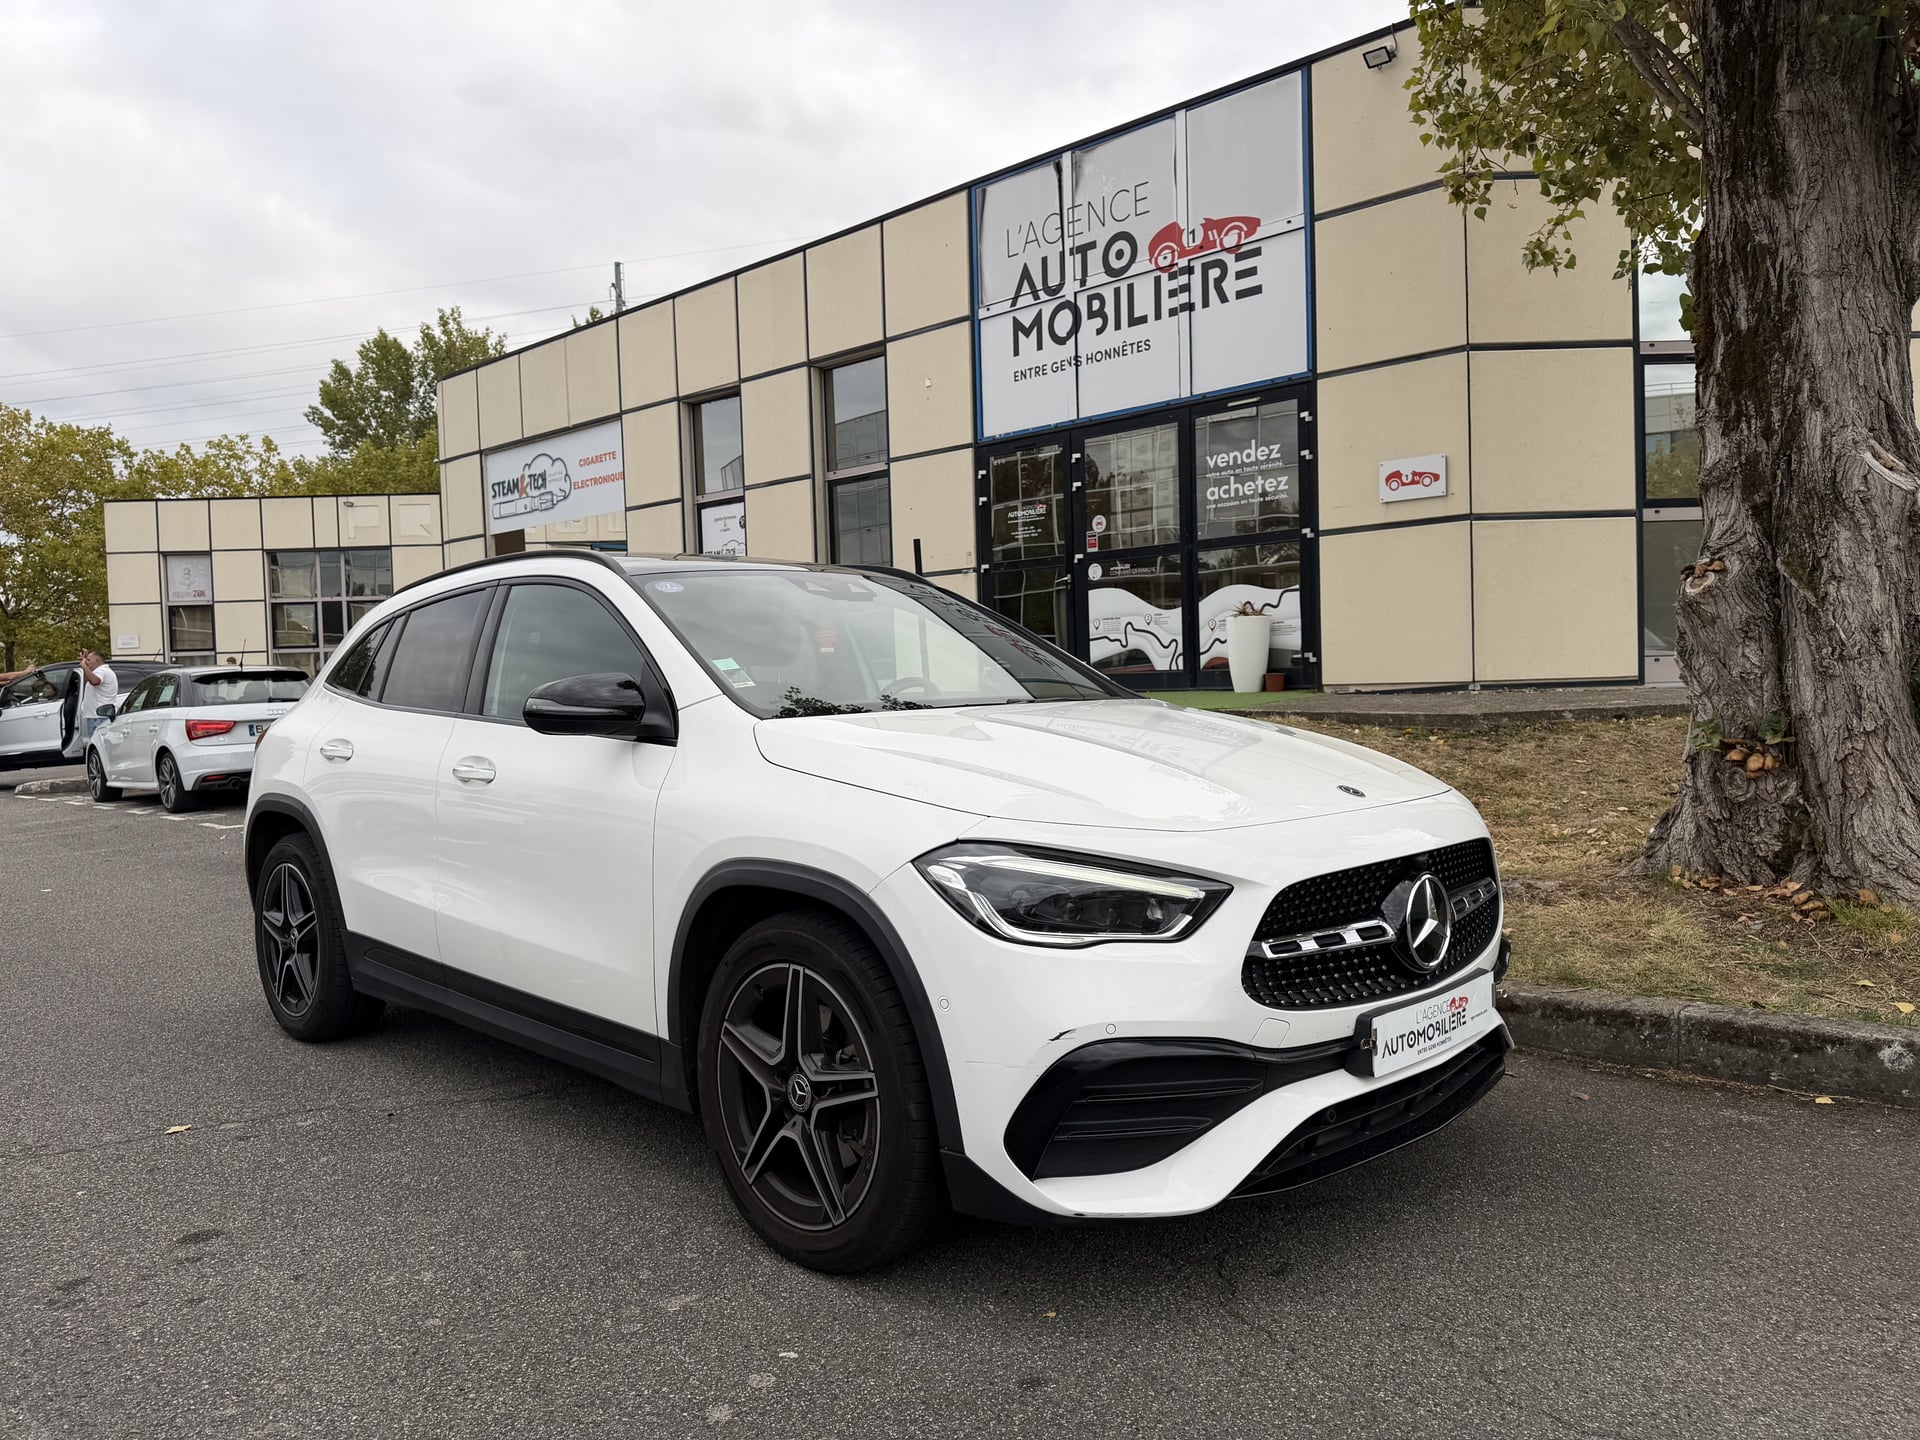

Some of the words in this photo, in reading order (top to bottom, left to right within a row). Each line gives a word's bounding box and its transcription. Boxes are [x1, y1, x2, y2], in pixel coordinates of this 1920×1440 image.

[1006, 181, 1150, 258] L'AGENCE
[1010, 230, 1138, 308] AUTO
[1013, 363, 1048, 382] ENTRE
[1050, 355, 1083, 374] GENS
[1085, 338, 1152, 365] HONNÊTES
[578, 450, 617, 468] CIGARETTE
[1205, 439, 1281, 469] vendez
[572, 471, 625, 490] ELECTRONIQUE
[1206, 475, 1288, 501] achetez
[1415, 1000, 1450, 1025] L'AGENCE
